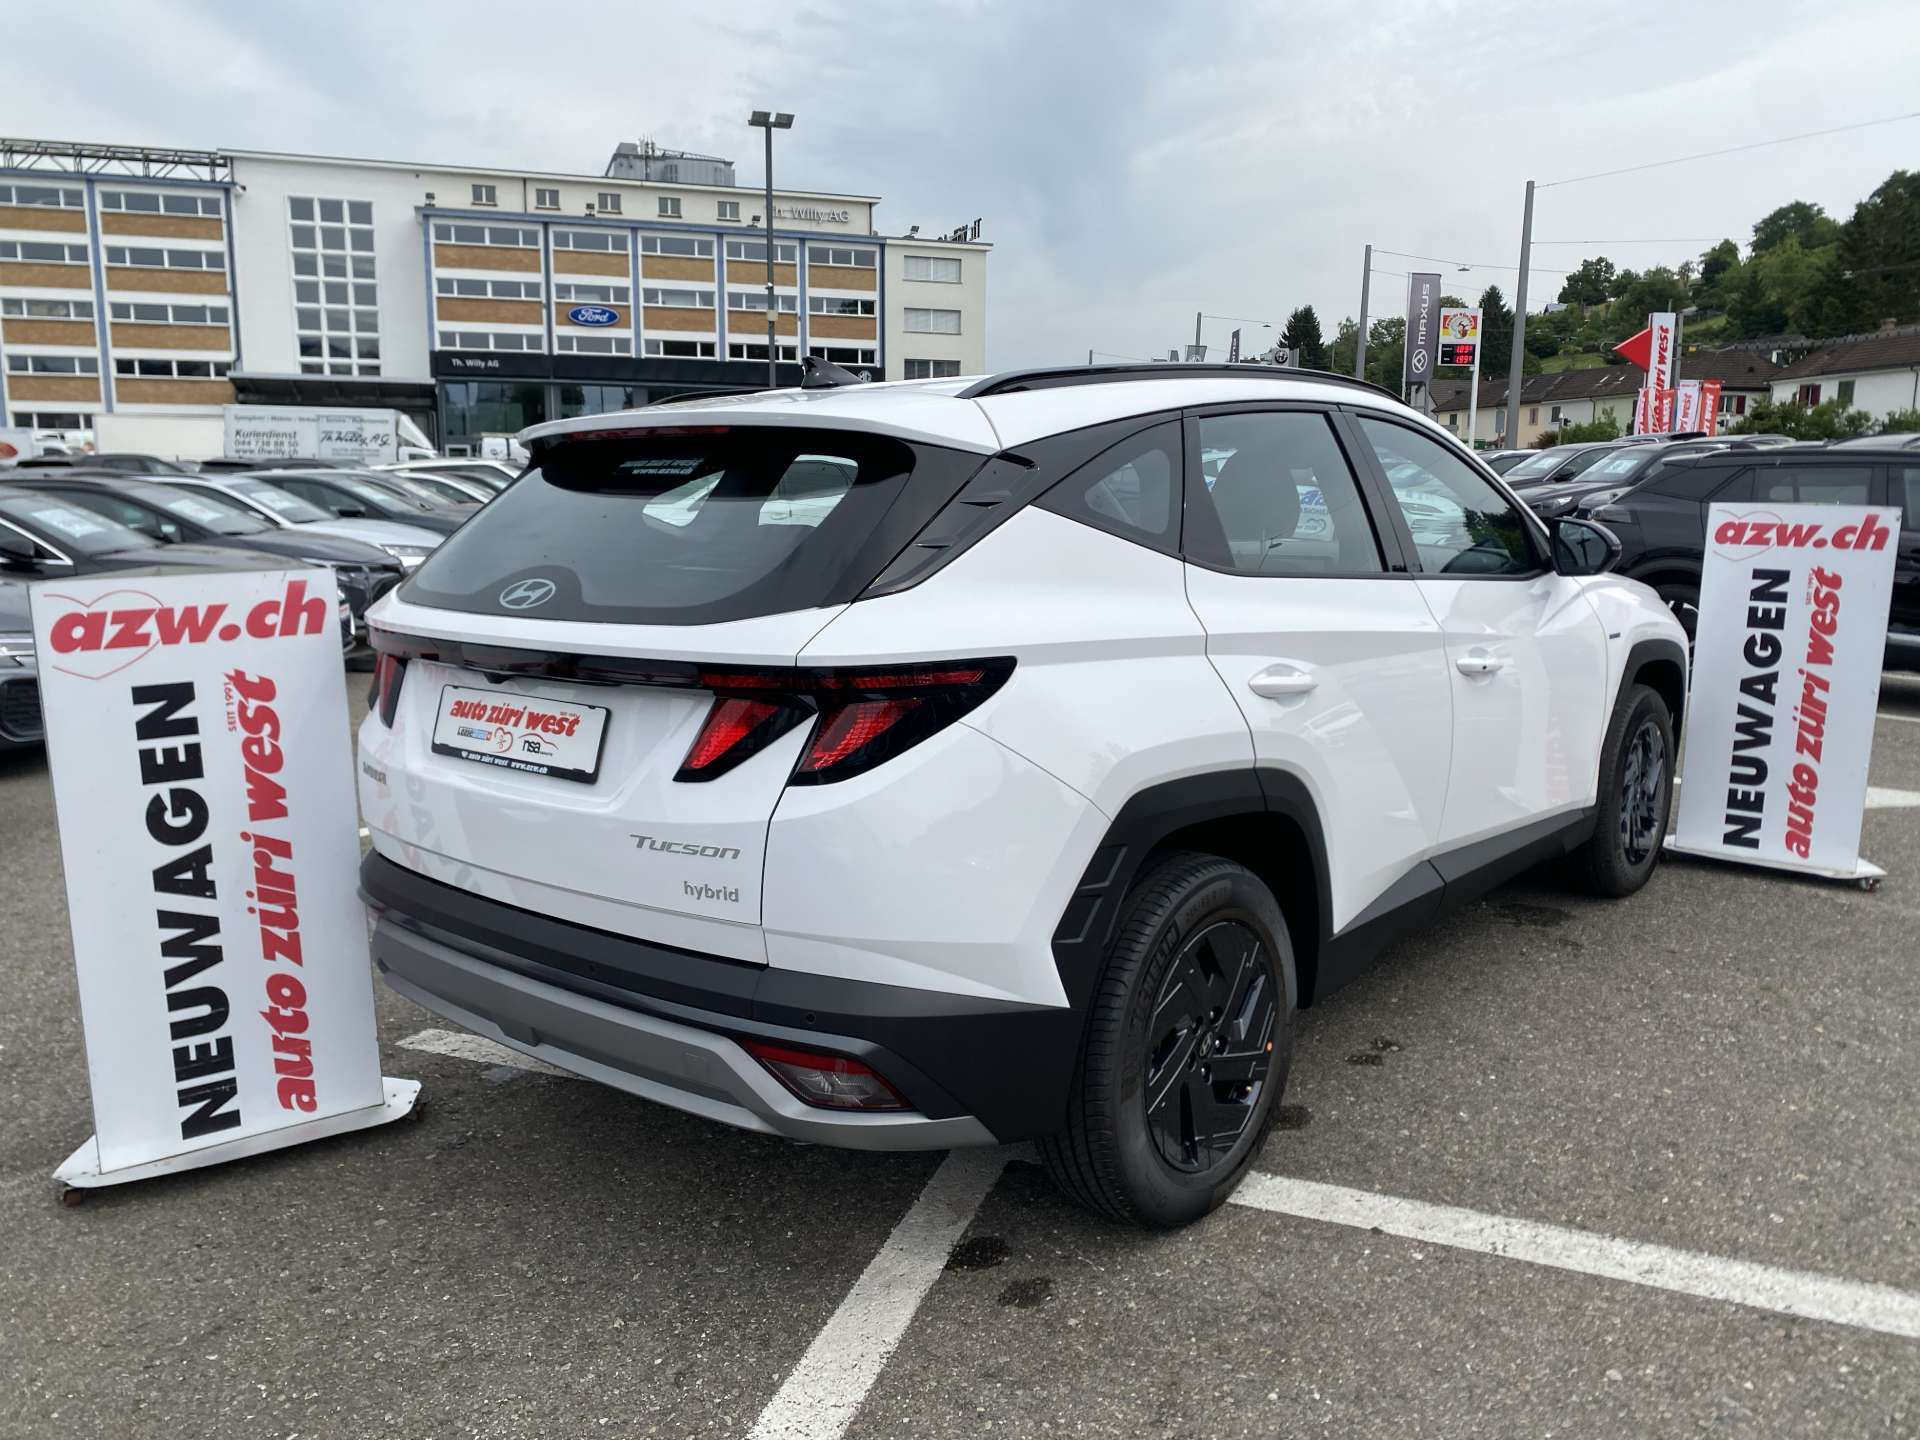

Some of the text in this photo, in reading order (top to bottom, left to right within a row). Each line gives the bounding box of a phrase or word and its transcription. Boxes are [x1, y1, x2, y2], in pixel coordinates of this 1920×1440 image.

[792, 207, 824, 223] Willy
[830, 210, 849, 223] AG
[578, 308, 609, 322] Ford
[465, 359, 485, 369] Willy
[487, 360, 499, 368] AG
[1657, 325, 1669, 365] west
[235, 429, 297, 439] Kurierdienst
[1714, 513, 1890, 551] azw.ch
[49, 579, 327, 655] azw.ch
[224, 682, 237, 732] SEIT 1991
[450, 700, 581, 737] auto züri west
[1723, 567, 1791, 850] NEUWAGEN
[1781, 564, 1844, 860] auto züri west
[522, 738, 541, 754] nsa
[131, 680, 242, 1141] NEUWAGEN
[222, 668, 319, 1115] auto züri west
[683, 880, 739, 903] hybrid
